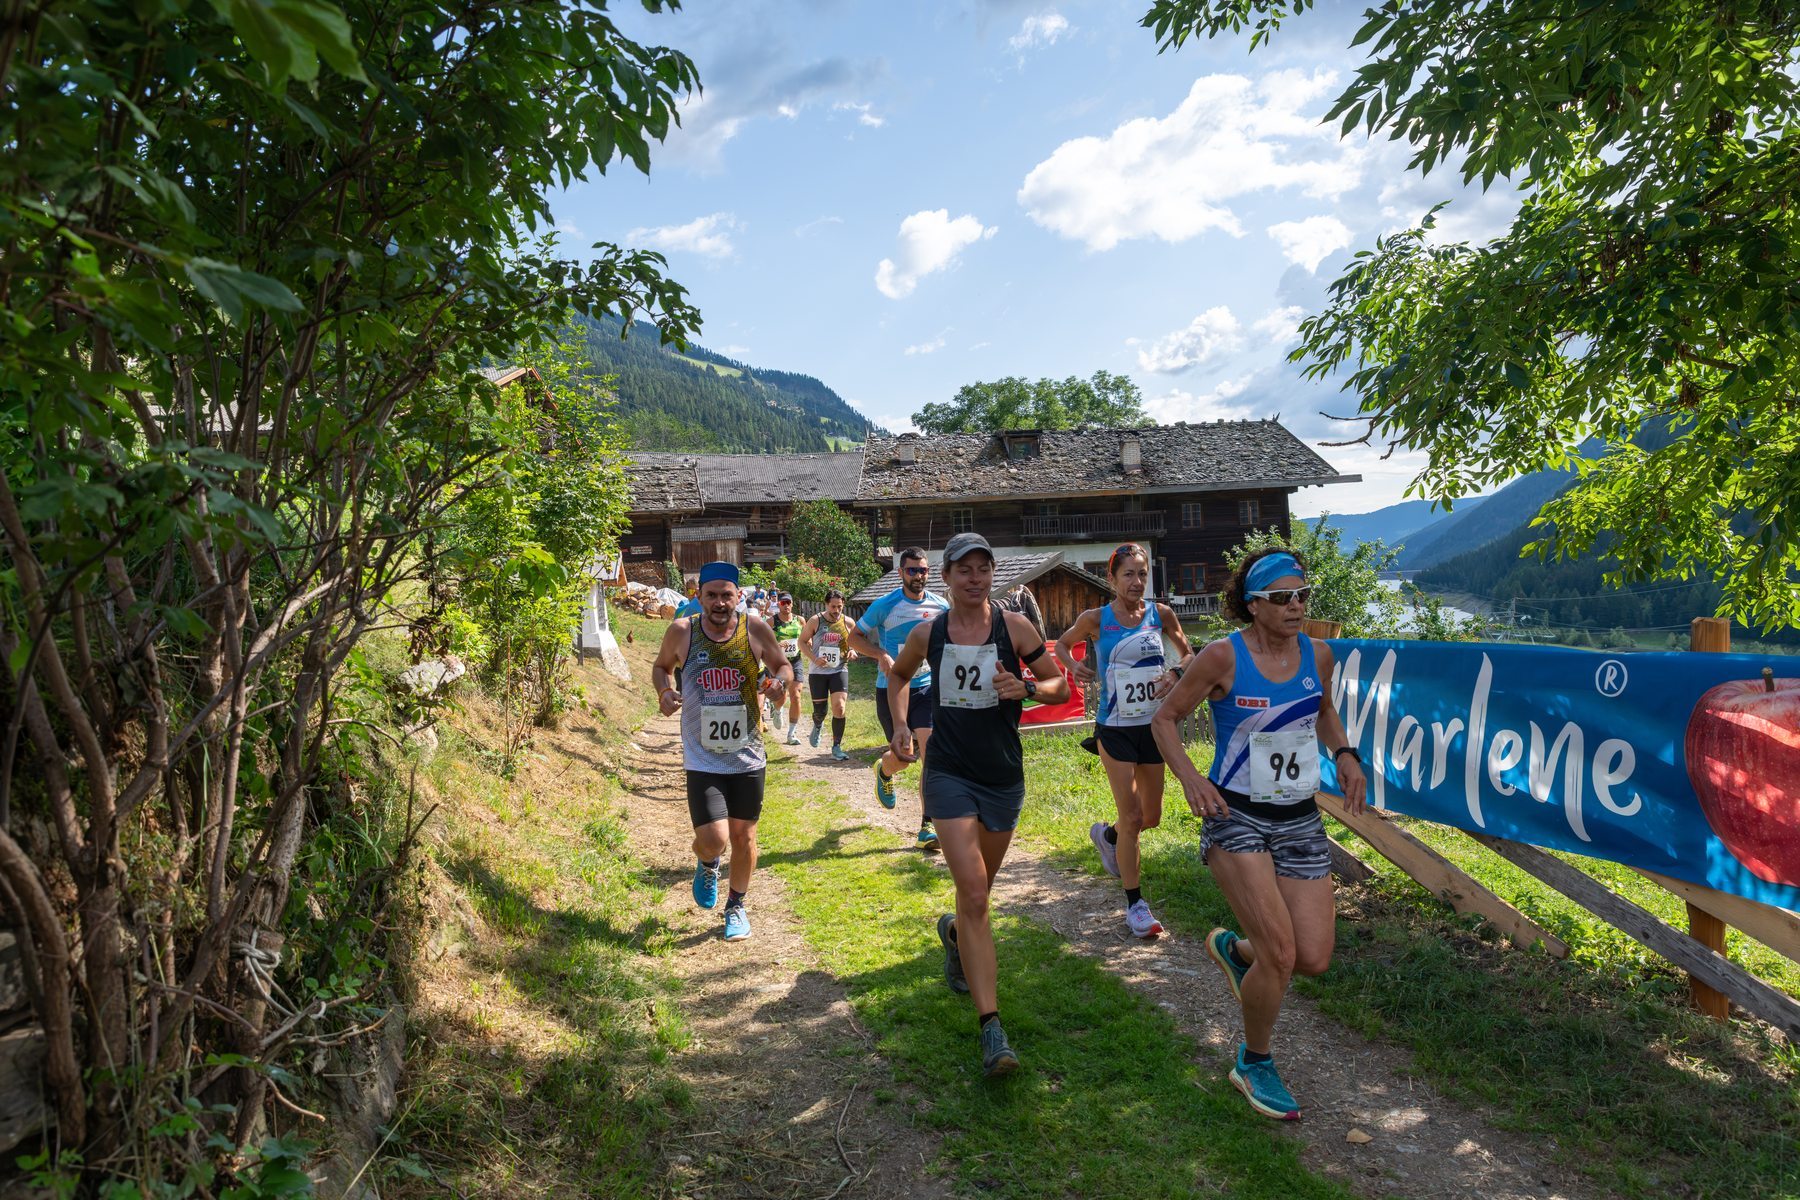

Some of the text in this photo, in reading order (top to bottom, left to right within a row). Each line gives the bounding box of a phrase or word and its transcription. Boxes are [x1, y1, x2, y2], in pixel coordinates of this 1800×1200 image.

[702, 667, 740, 691] FIDAS
[954, 664, 982, 691] 92
[1124, 681, 1156, 704] 230
[1236, 697, 1268, 708] OBI
[709, 720, 741, 741] 206
[1329, 647, 1643, 843] Marlene
[1269, 752, 1300, 782] 96
